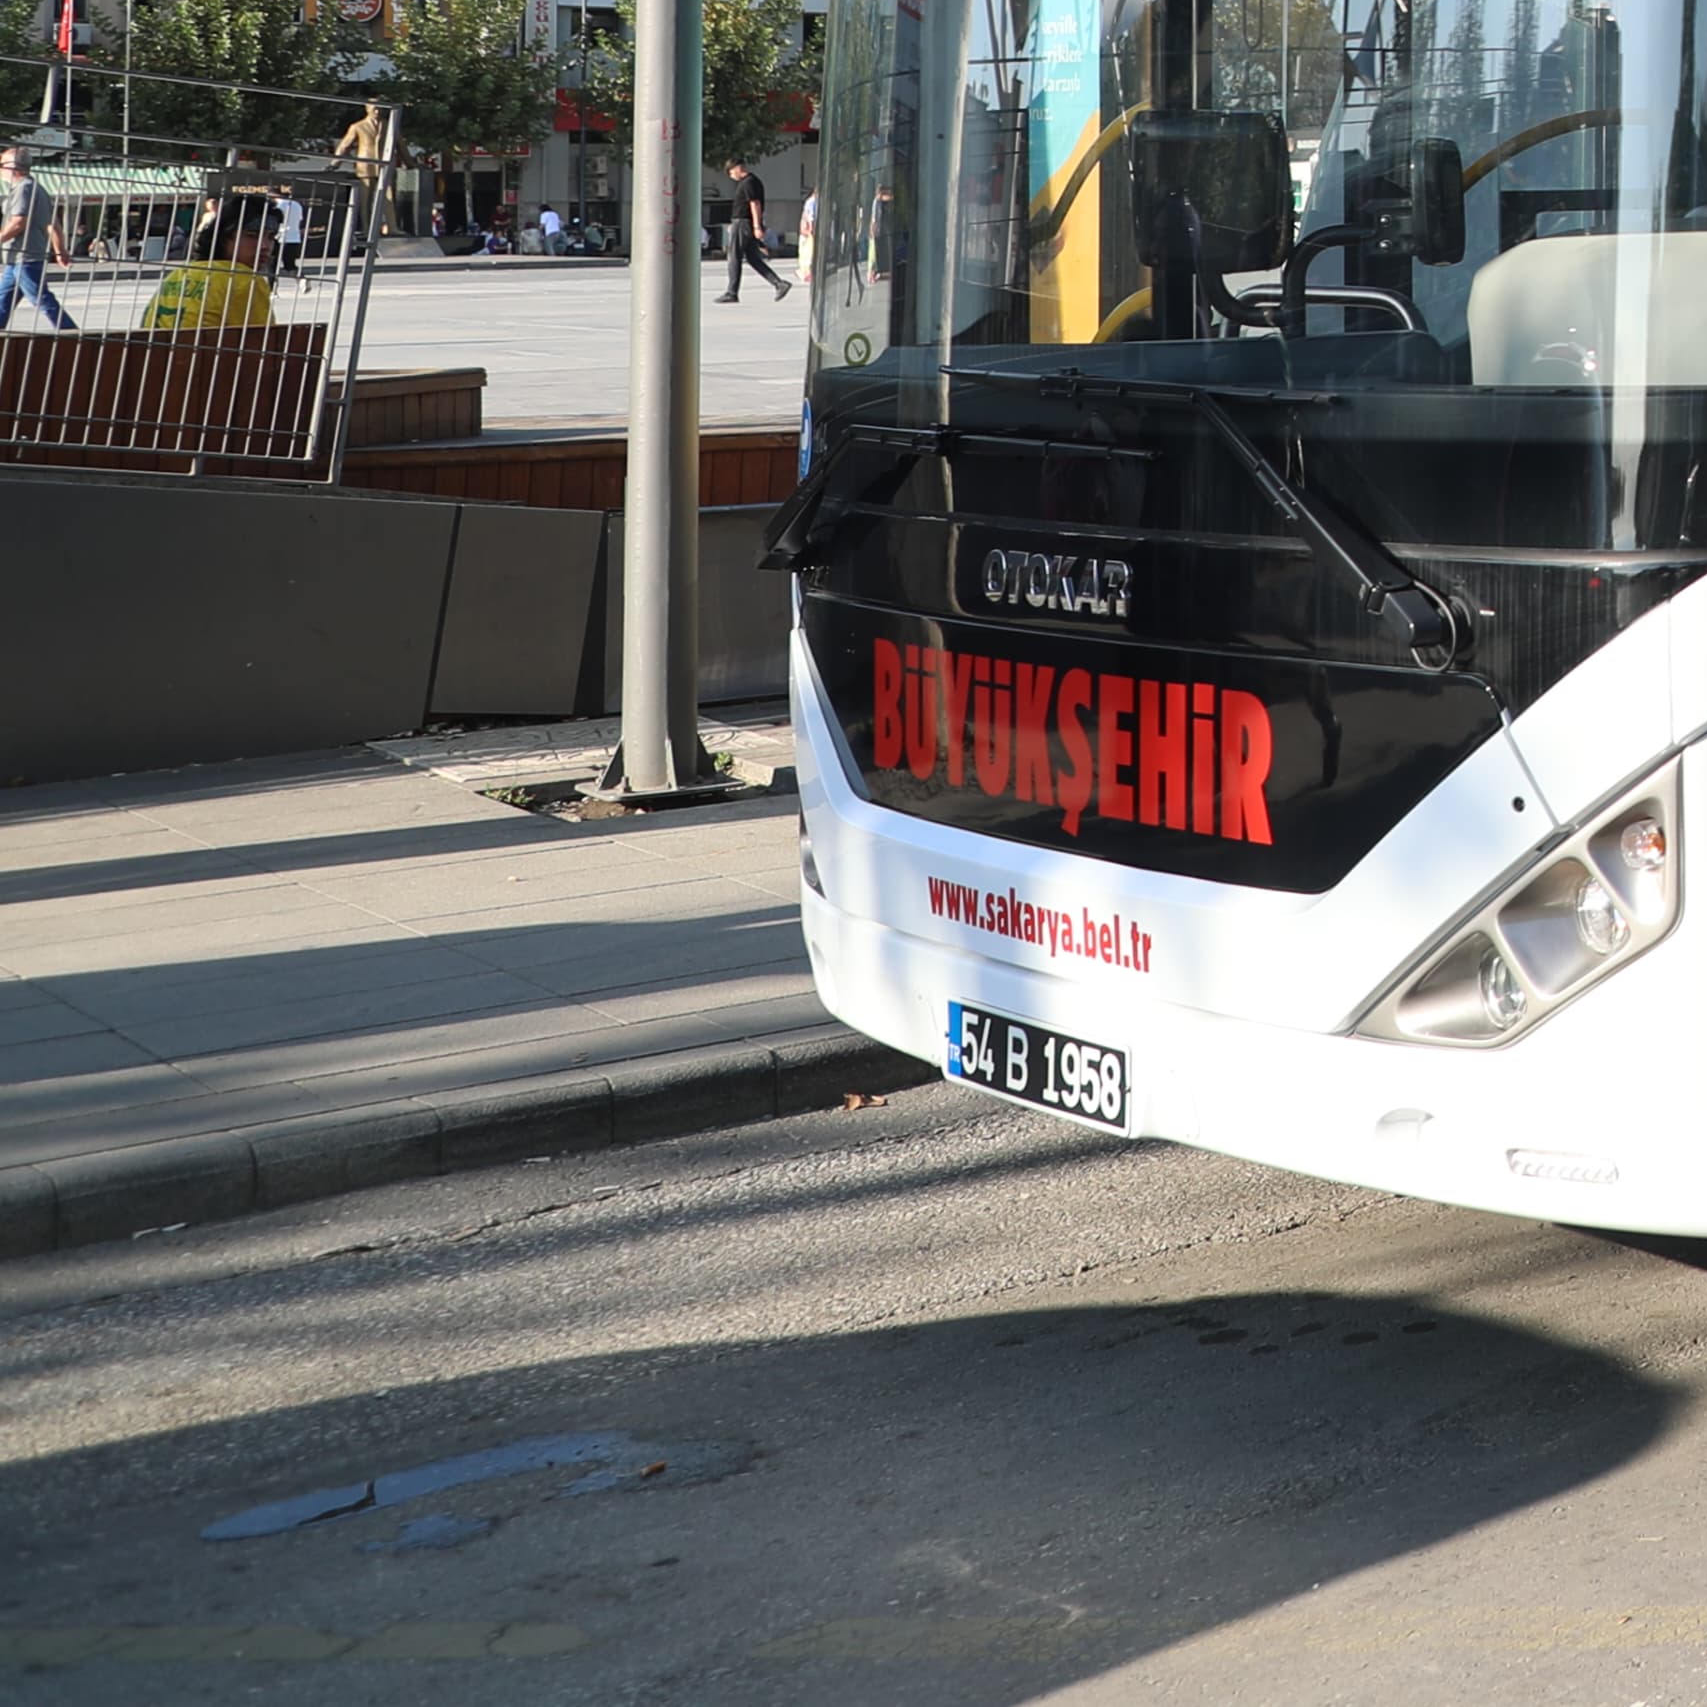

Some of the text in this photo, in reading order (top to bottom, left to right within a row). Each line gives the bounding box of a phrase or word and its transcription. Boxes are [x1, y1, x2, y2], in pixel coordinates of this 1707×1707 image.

[982, 549, 1133, 615] OTOKAR
[874, 637, 1272, 845] BÜYÜKŞEHİR
[928, 876, 1151, 973] www.sakarya.bel.tr
[961, 1011, 994, 1082] 54
[1006, 1025, 1028, 1092] B
[1043, 1037, 1121, 1120] 1958
